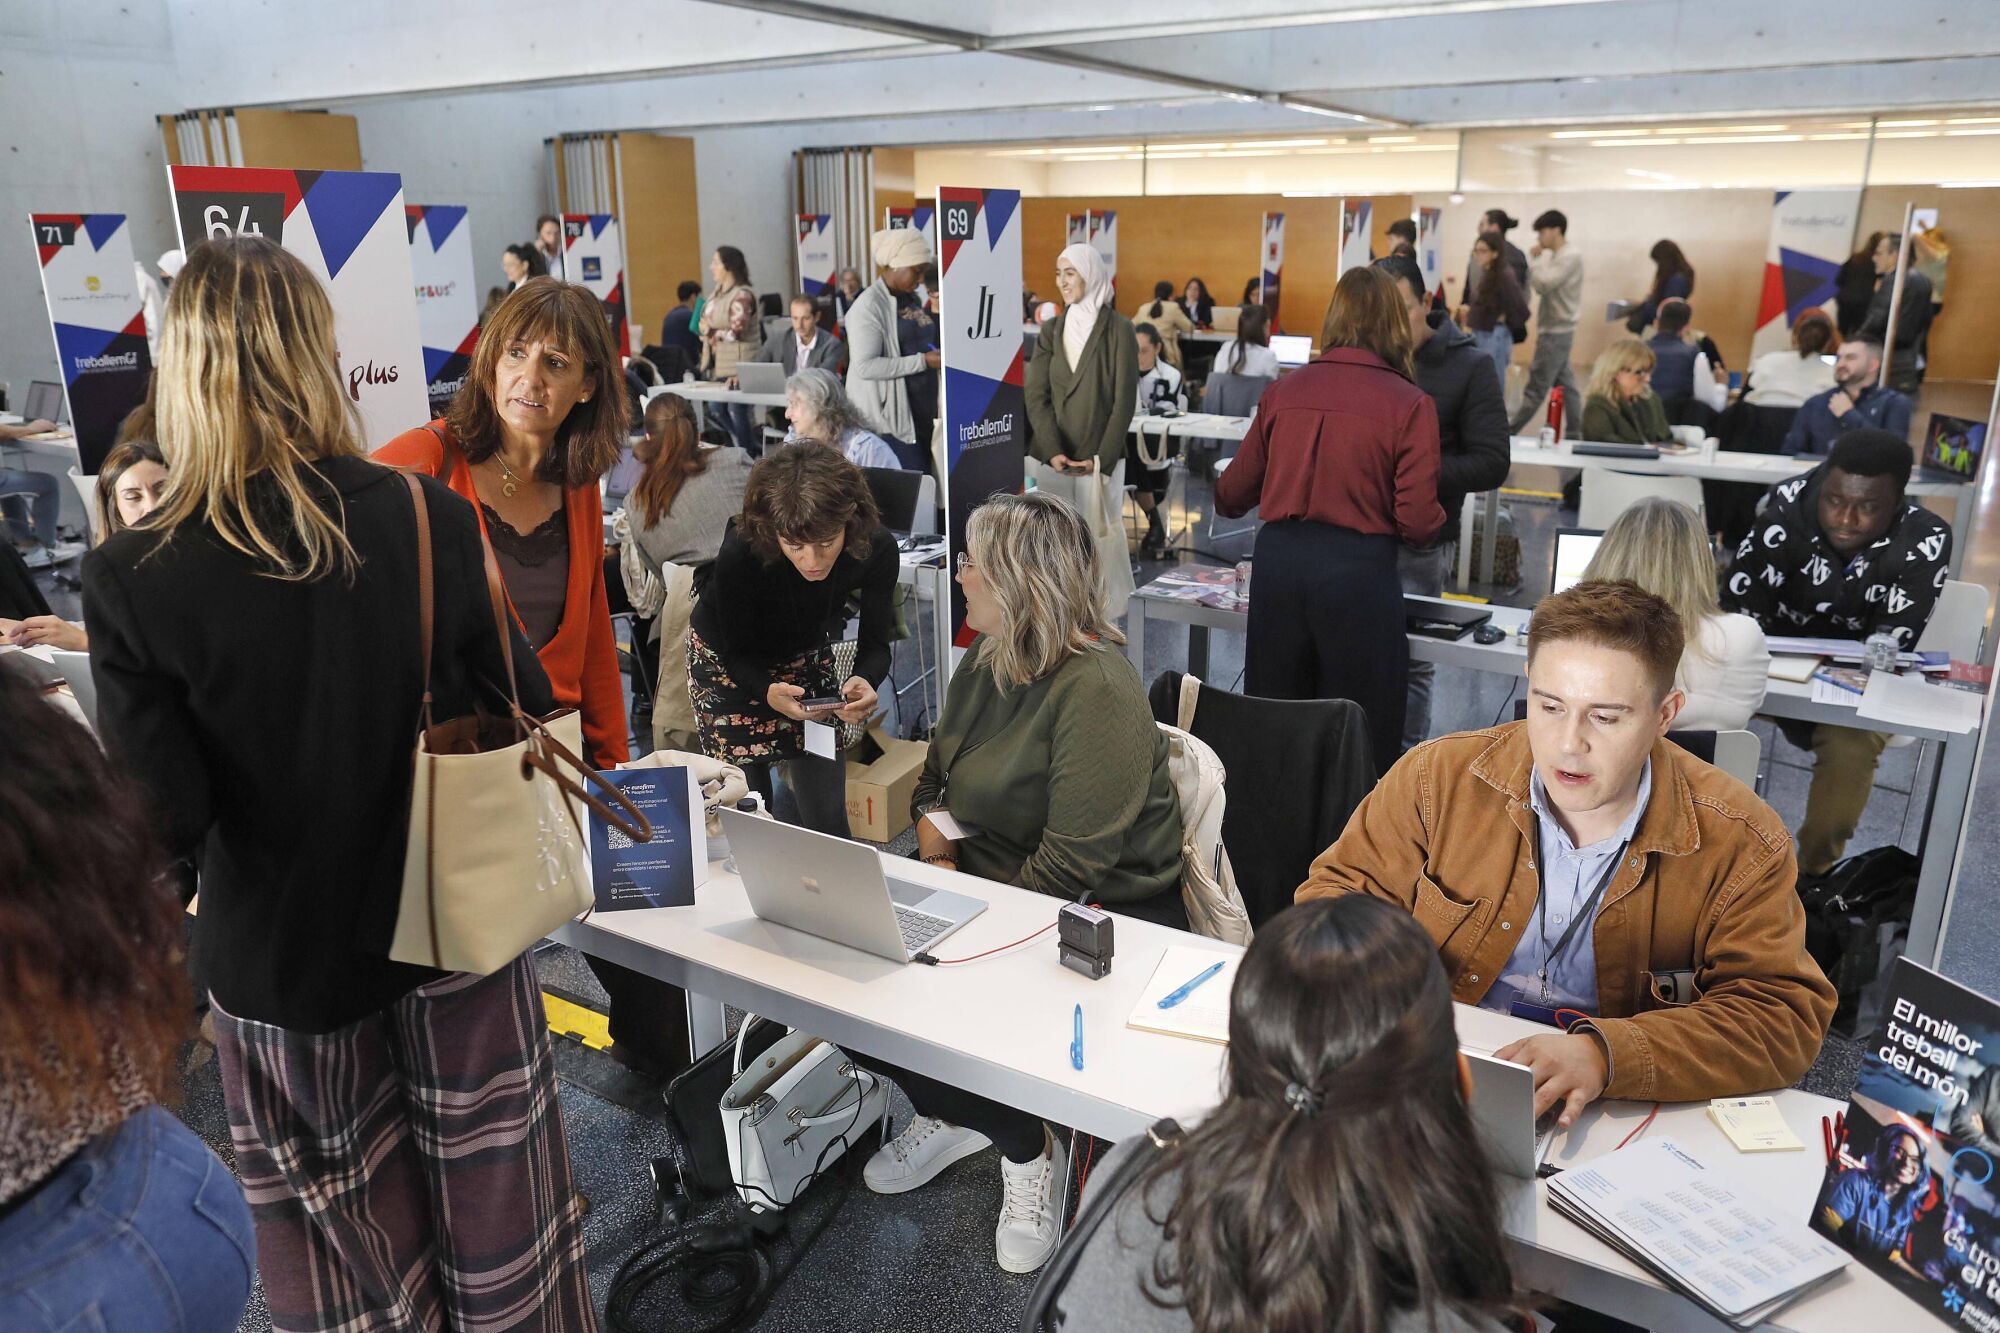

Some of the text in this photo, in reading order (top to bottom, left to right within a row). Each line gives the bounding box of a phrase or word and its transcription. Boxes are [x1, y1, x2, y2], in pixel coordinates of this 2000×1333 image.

[41, 226, 63, 244] 71
[947, 208, 969, 235] 69
[967, 285, 1002, 340] JL
[349, 359, 399, 401] plus
[959, 413, 1013, 441] treballemGi
[1887, 1020, 1959, 1072] treball
[1893, 997, 1984, 1056] El millor
[1879, 1046, 1970, 1106] del món
[1944, 1227, 2000, 1280] és tro
[1961, 1264, 1986, 1289] el
